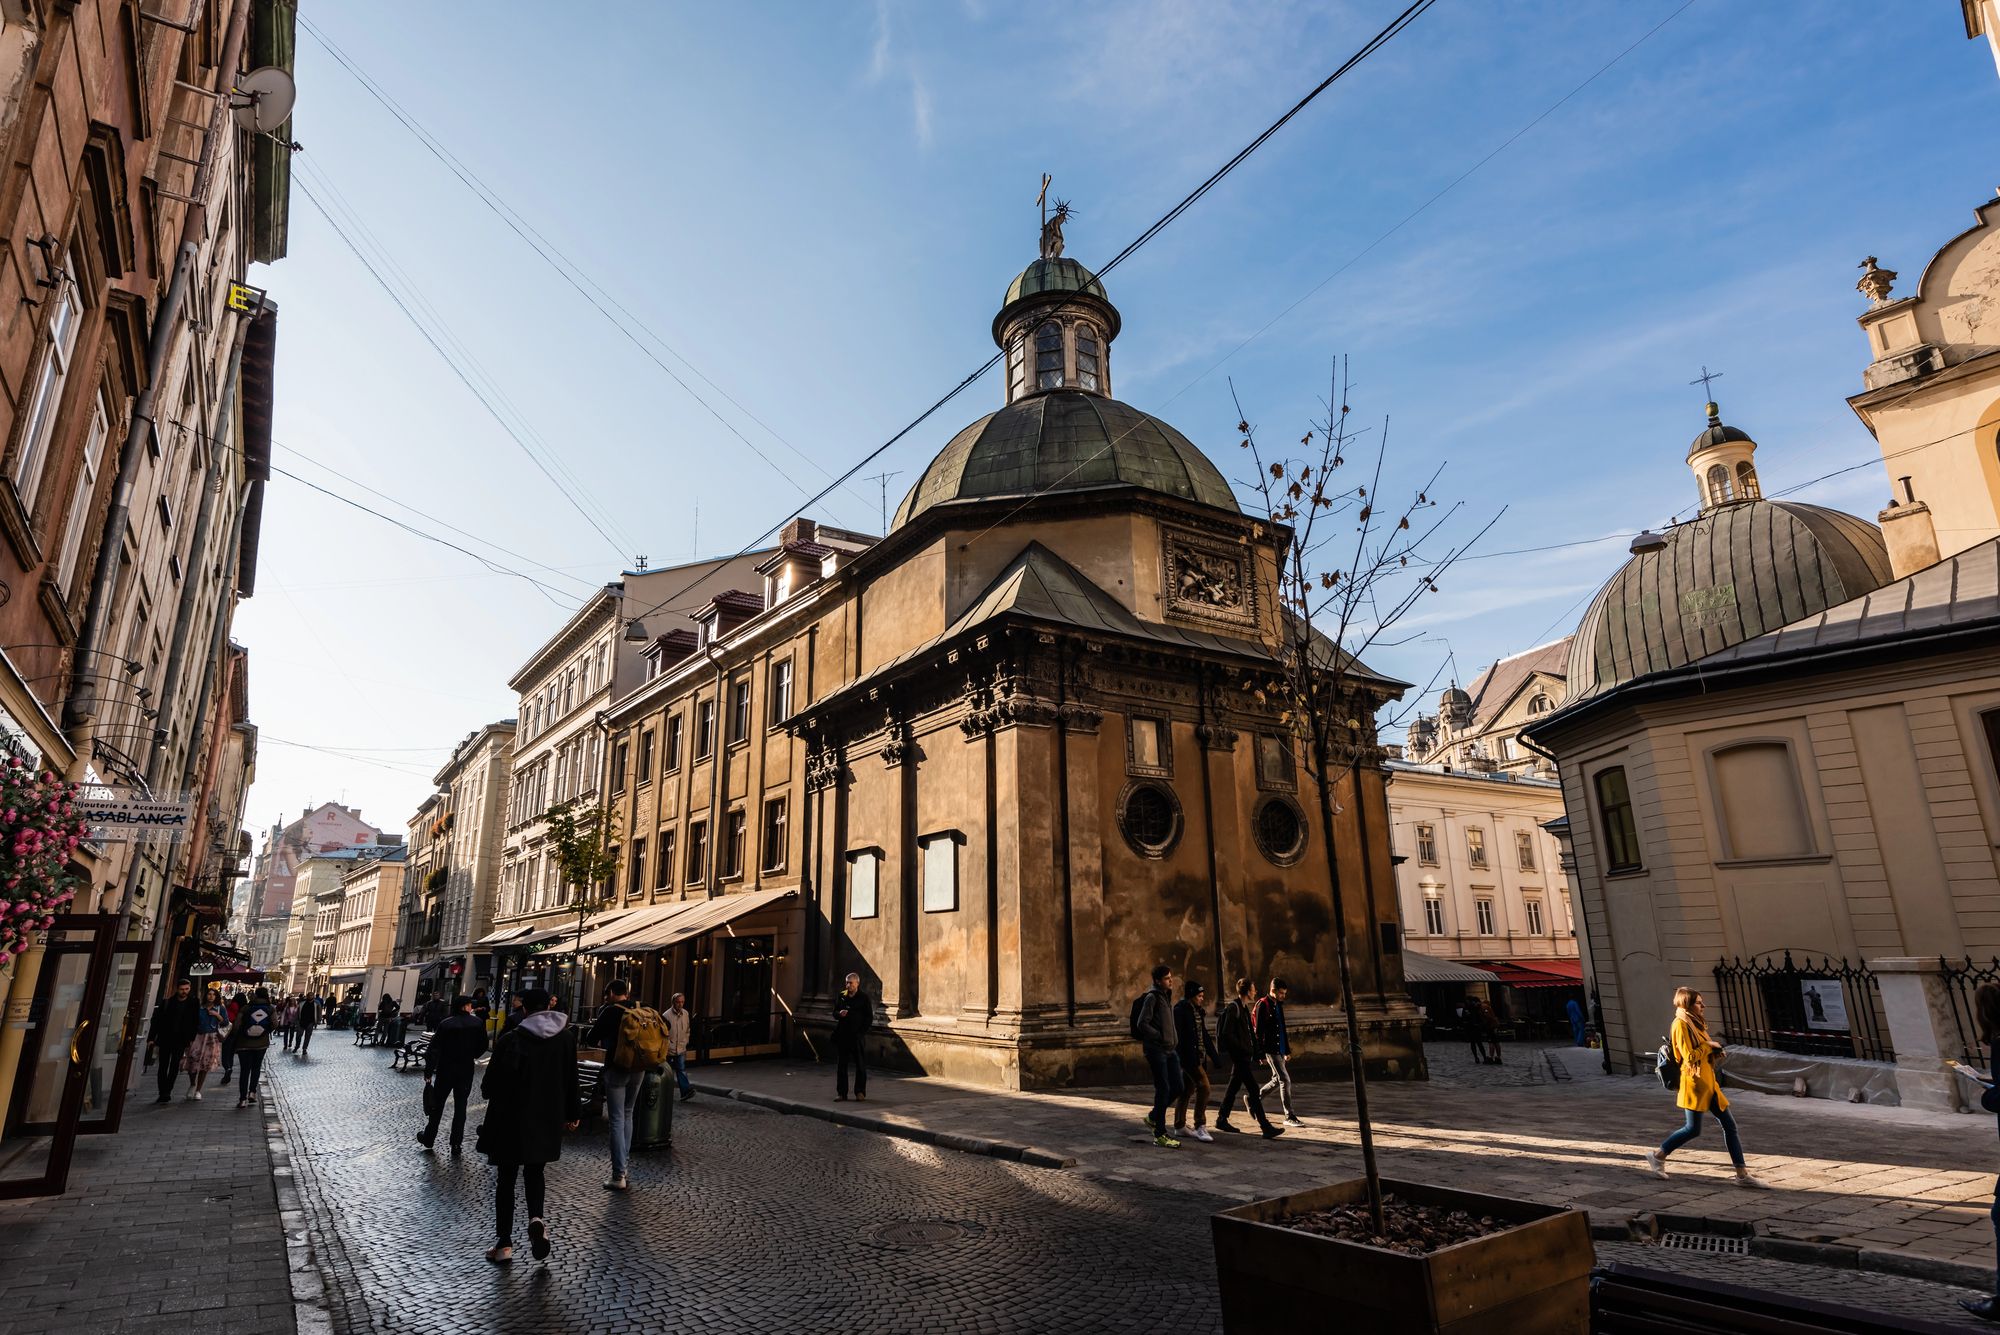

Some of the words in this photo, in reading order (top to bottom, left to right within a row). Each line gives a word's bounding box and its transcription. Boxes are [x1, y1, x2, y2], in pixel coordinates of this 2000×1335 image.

[230, 285, 253, 311] E
[133, 804, 184, 813] Accessories
[82, 810, 184, 825] ASABLANCA
